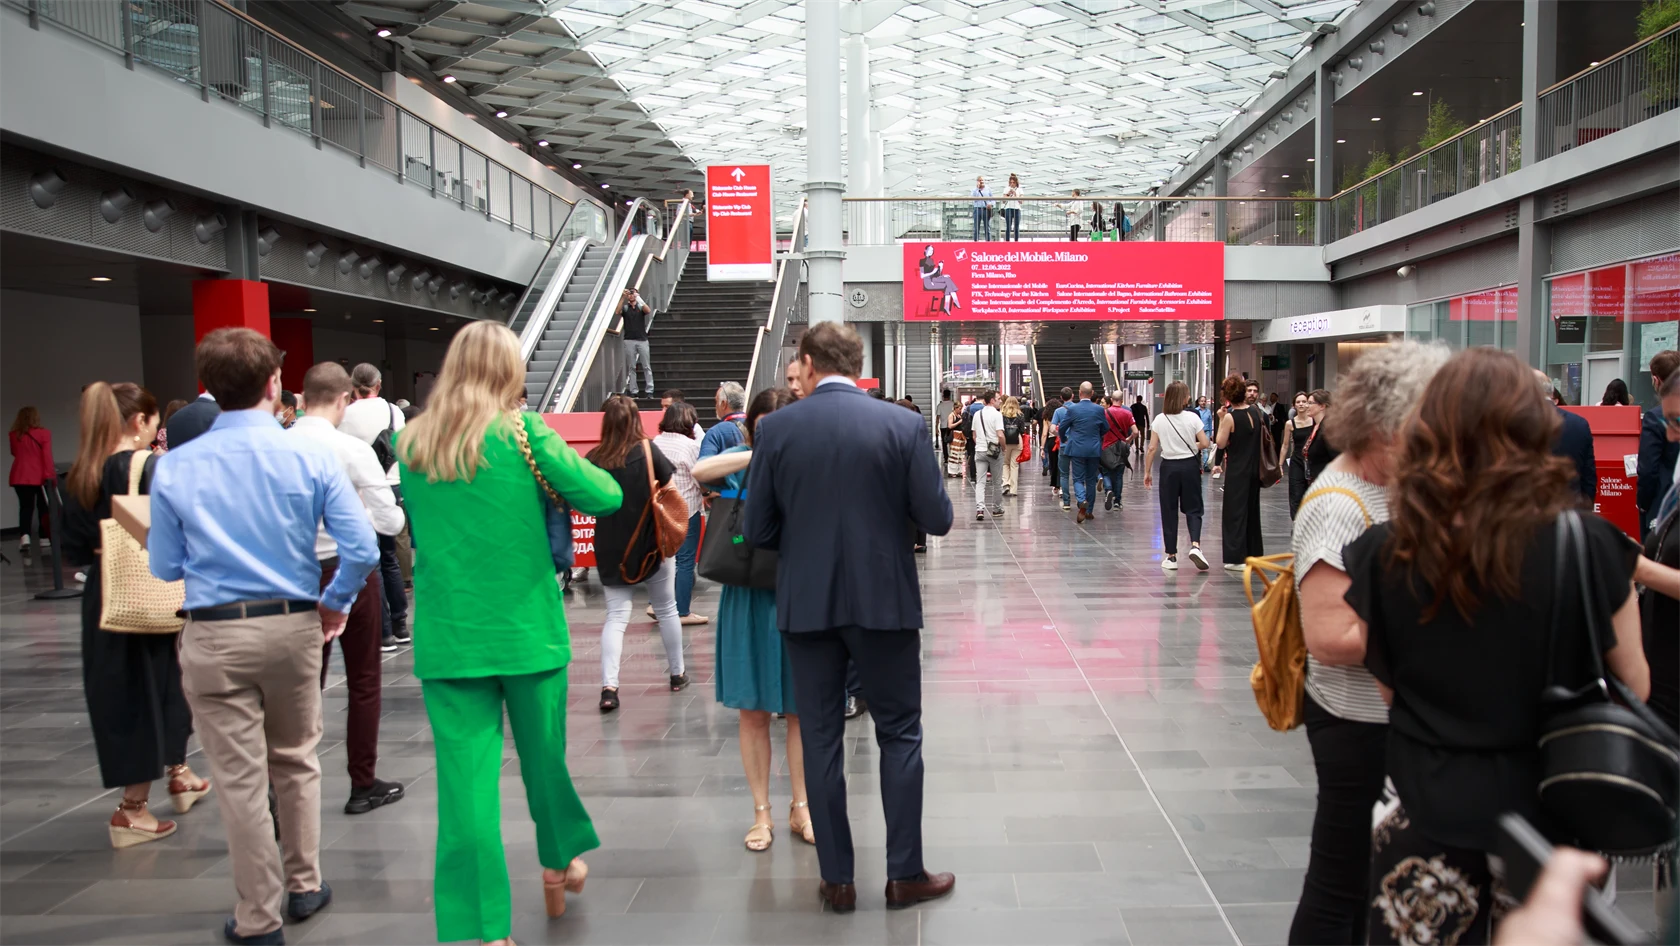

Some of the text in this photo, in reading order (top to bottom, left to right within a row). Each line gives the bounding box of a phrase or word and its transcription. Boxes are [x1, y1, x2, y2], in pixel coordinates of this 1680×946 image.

[971, 252, 1004, 262] Salone
[1004, 252, 1019, 262] del
[1290, 317, 1329, 334] reception
